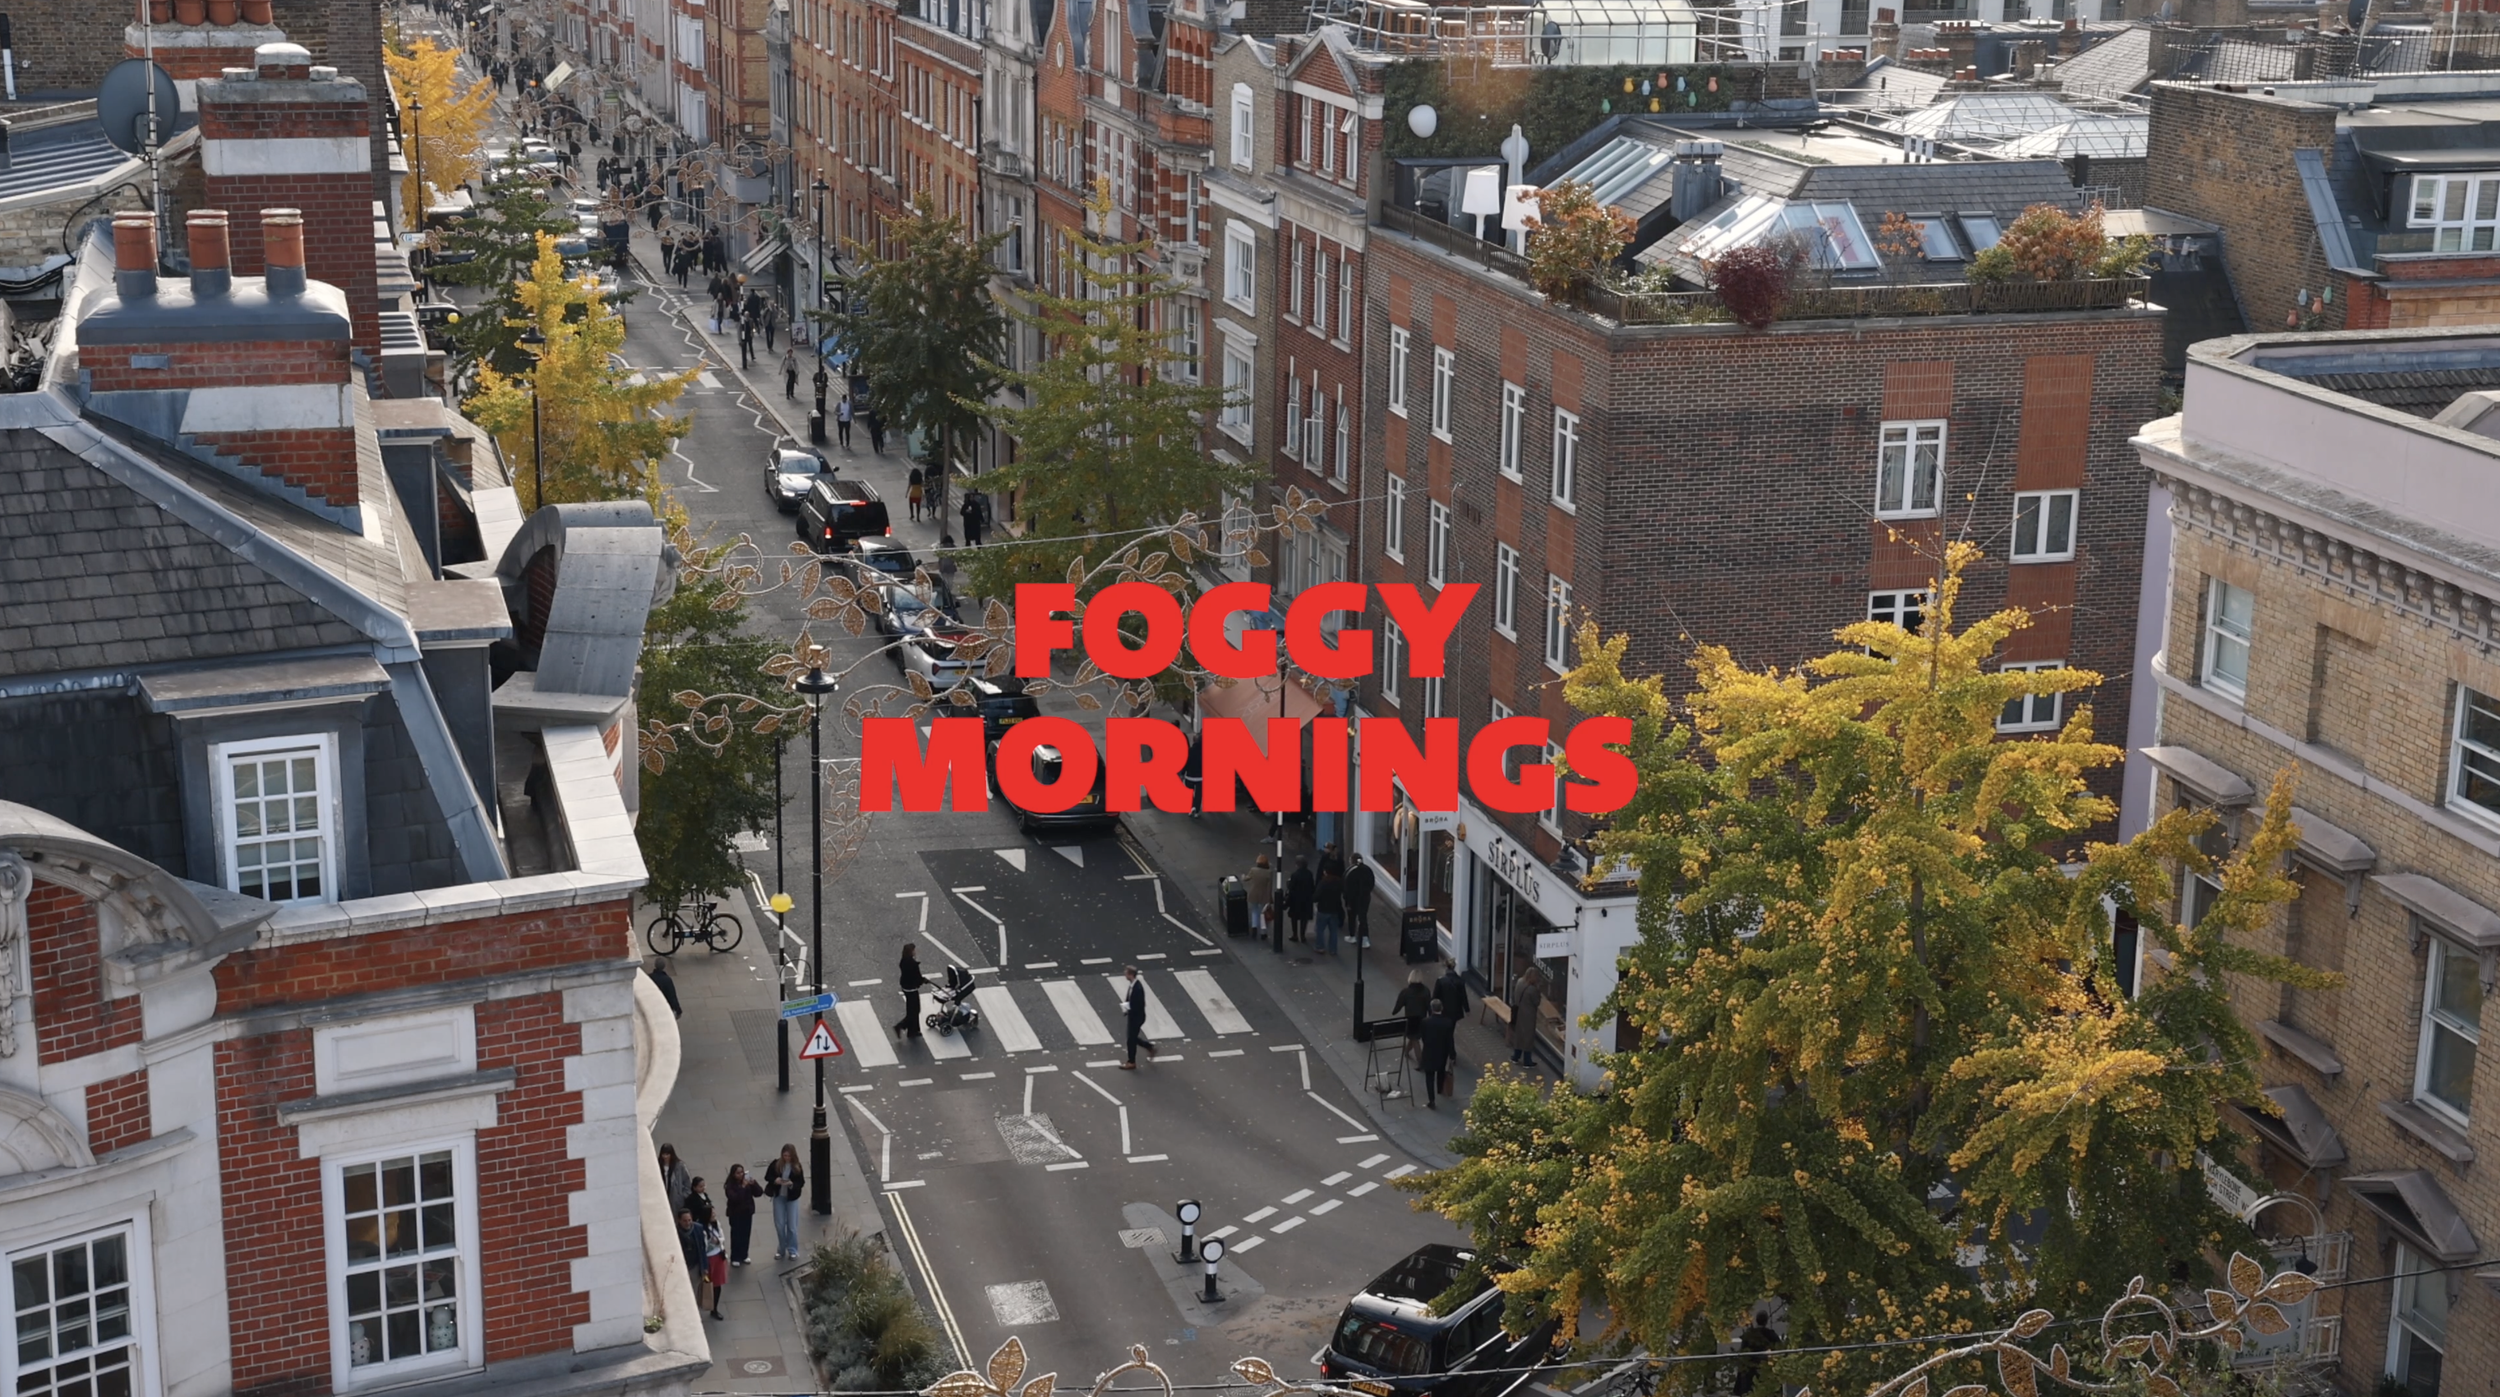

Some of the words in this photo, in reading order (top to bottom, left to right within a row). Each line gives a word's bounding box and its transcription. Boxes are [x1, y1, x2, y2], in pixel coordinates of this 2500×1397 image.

[1488, 841, 1540, 903] SIRPLUS
[2207, 1163, 2242, 1196] MARYLEBONE
[2218, 1184, 2239, 1206] STREET
